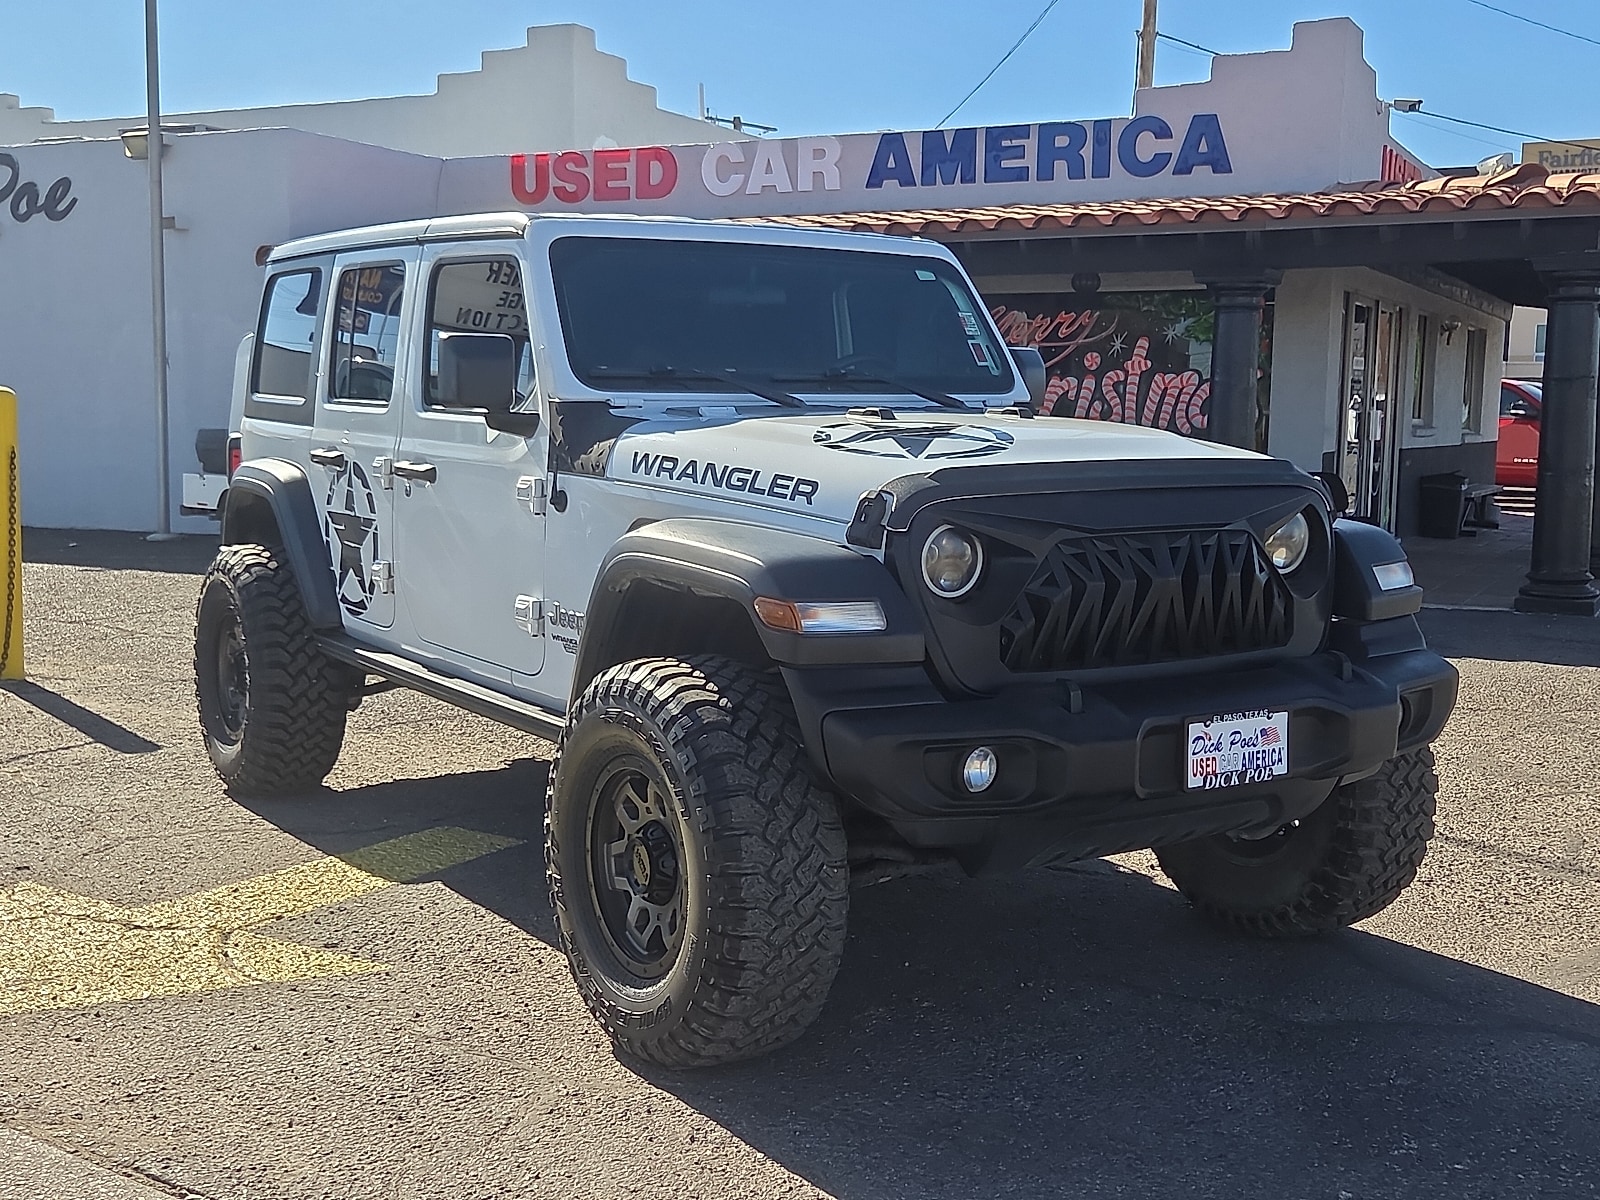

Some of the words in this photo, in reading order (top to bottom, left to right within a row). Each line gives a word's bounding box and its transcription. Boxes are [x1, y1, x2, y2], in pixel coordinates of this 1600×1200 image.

[510, 146, 678, 206] USED
[701, 136, 841, 196] CAR
[865, 113, 1233, 189] AMERICA
[632, 451, 819, 506] WRANGLER
[1213, 715, 1222, 724] EL
[1245, 708, 1269, 720] TEXAS
[1191, 733, 1224, 756] Dick
[1229, 727, 1260, 752] Poe's
[1191, 756, 1217, 778] USED
[1220, 752, 1240, 772] CAR
[1241, 747, 1283, 772] AMERICA
[1204, 771, 1241, 790] DICK
[1244, 767, 1274, 785] POE
